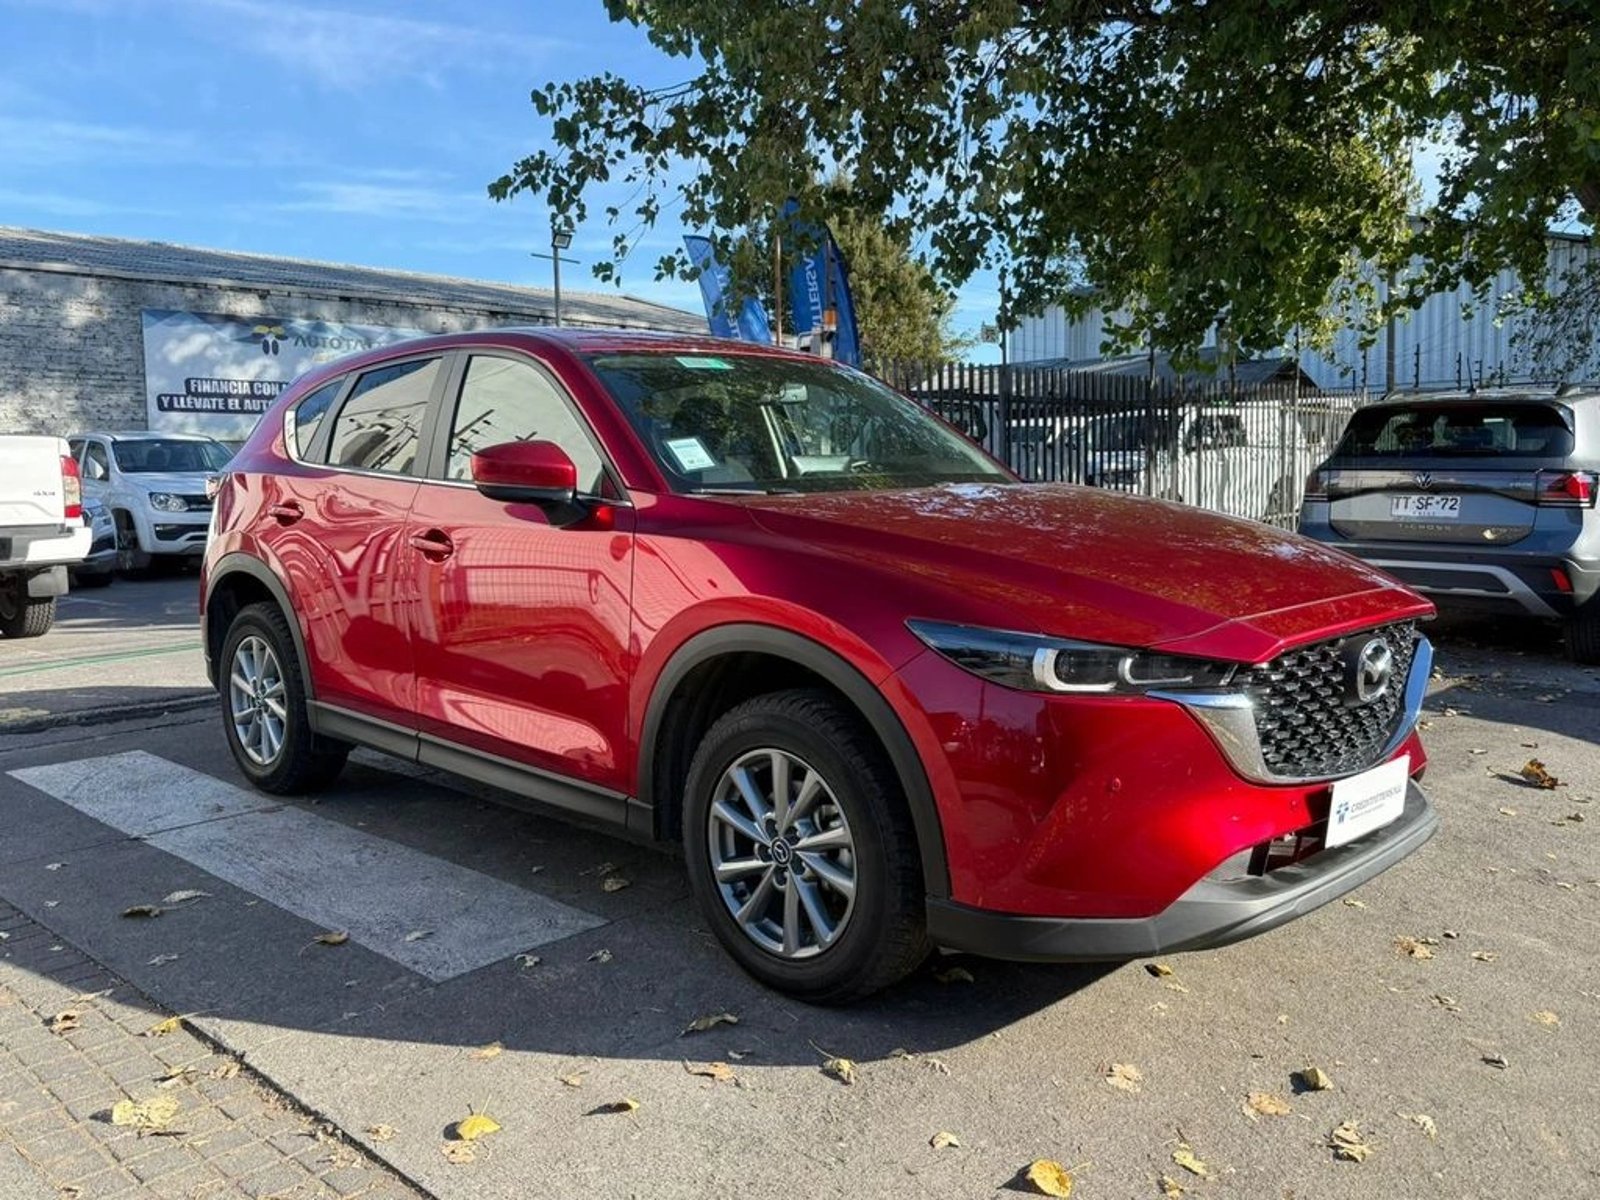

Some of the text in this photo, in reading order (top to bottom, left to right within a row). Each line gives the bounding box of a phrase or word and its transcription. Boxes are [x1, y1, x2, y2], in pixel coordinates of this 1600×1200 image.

[190, 379, 279, 396] FINANCIA CON
[161, 396, 170, 408] Y
[228, 398, 241, 411] EL
